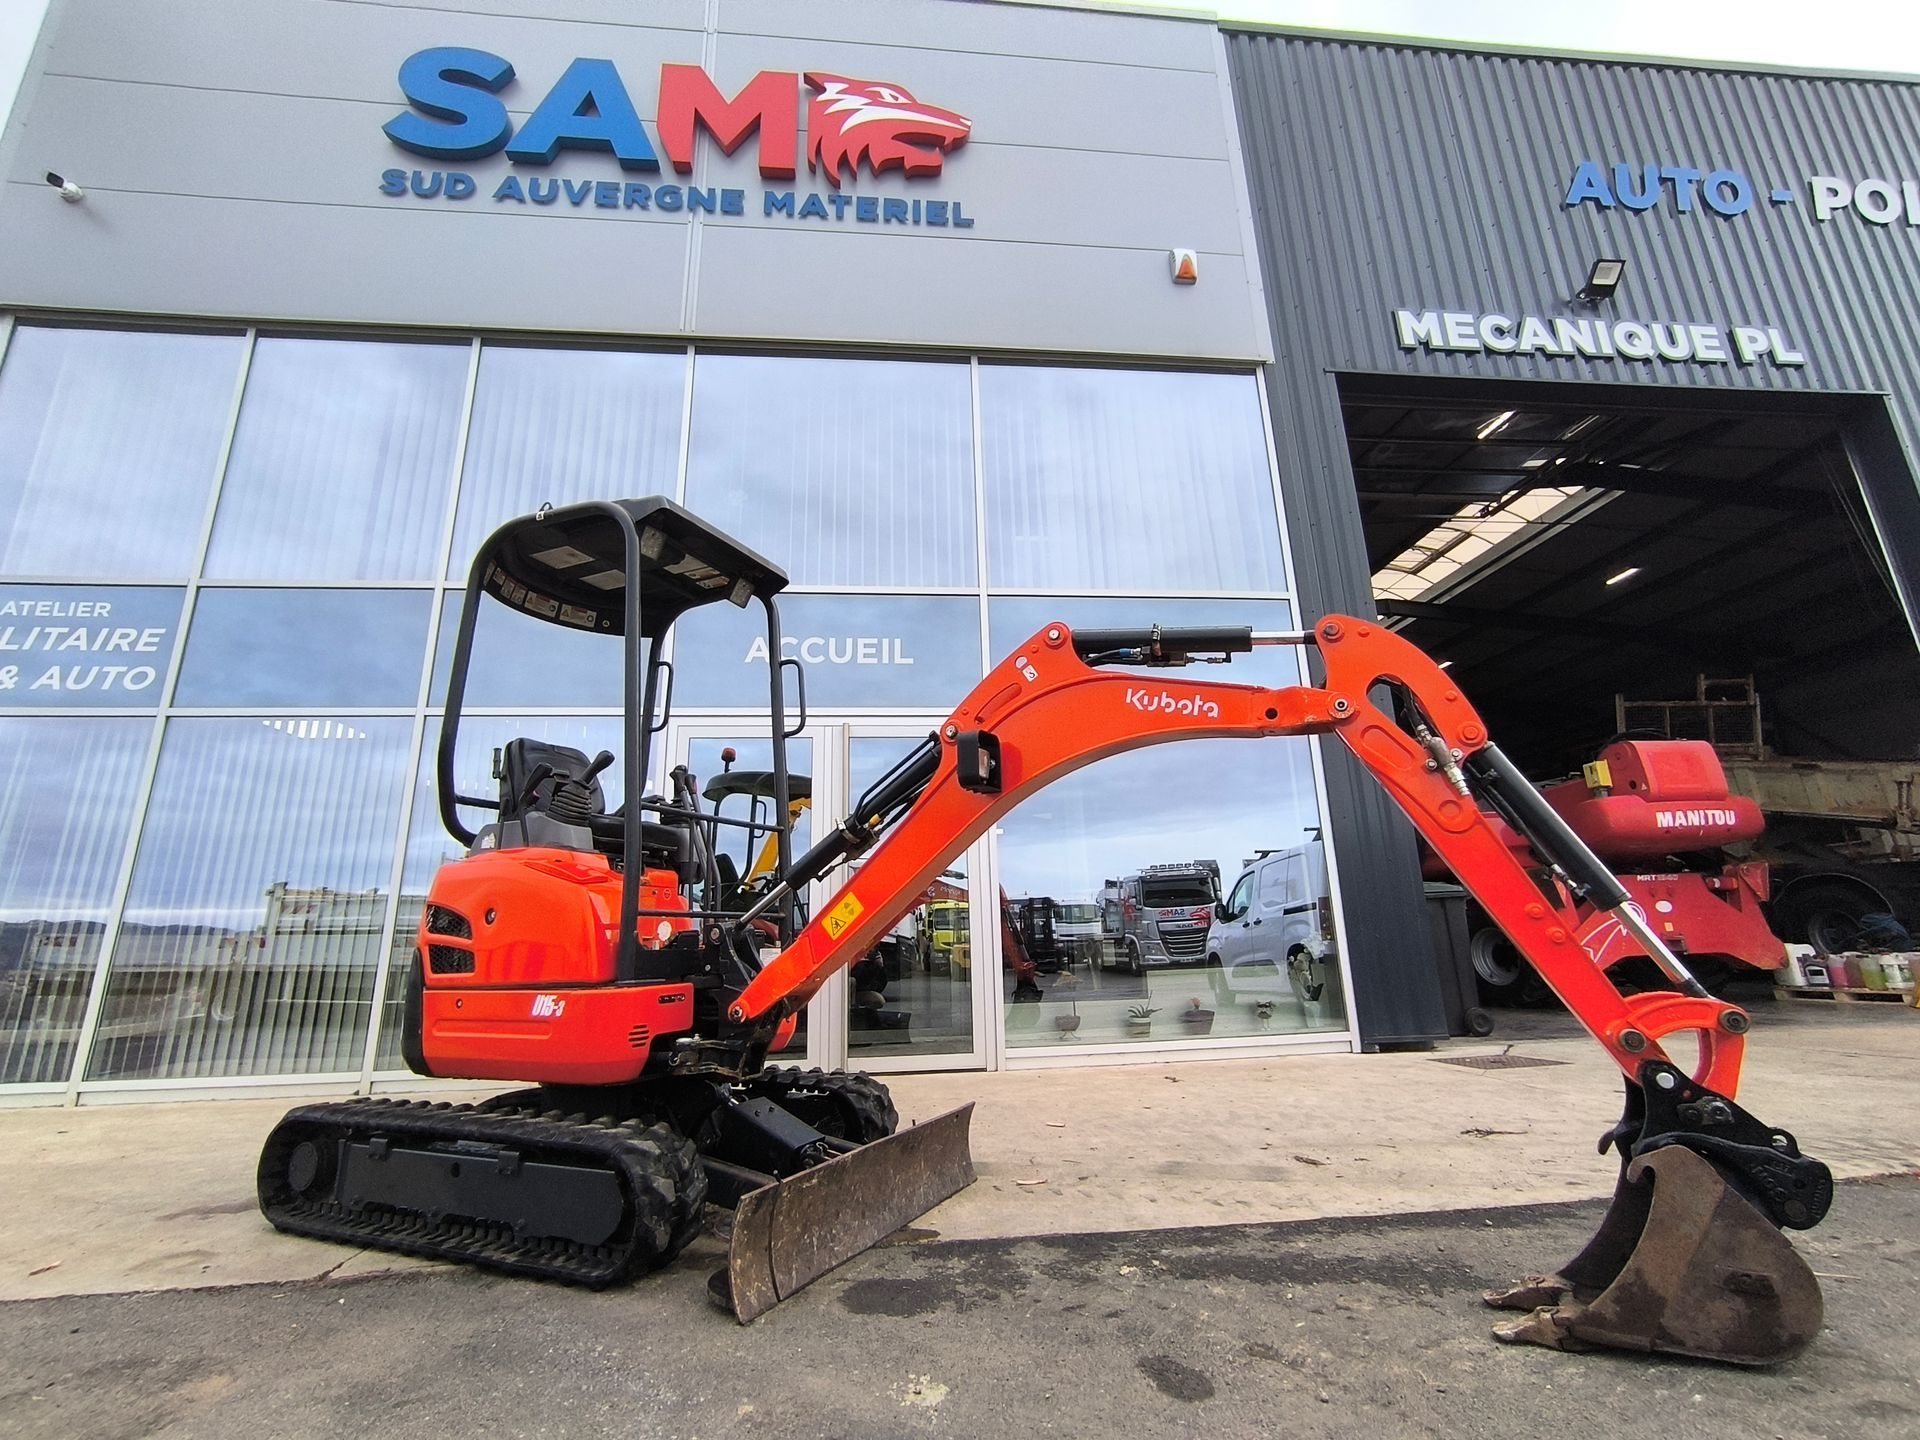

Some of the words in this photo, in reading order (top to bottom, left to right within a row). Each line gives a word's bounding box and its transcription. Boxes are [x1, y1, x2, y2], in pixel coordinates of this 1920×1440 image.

[382, 47, 799, 176] SAM
[379, 168, 476, 199] SUD
[492, 174, 745, 215] AUVERGNE
[763, 190, 975, 228] MATERIEL
[1565, 160, 1752, 215] AUTO
[1396, 309, 1728, 362] MECANIQUE
[1732, 324, 1807, 364] PL
[0, 600, 112, 617] ATELIER
[0, 626, 167, 652] LITAIRE
[744, 636, 914, 665] ACCUEIL
[29, 665, 156, 691] AUTO
[1125, 687, 1220, 718] Kubota
[1655, 809, 1736, 828] MANITOU
